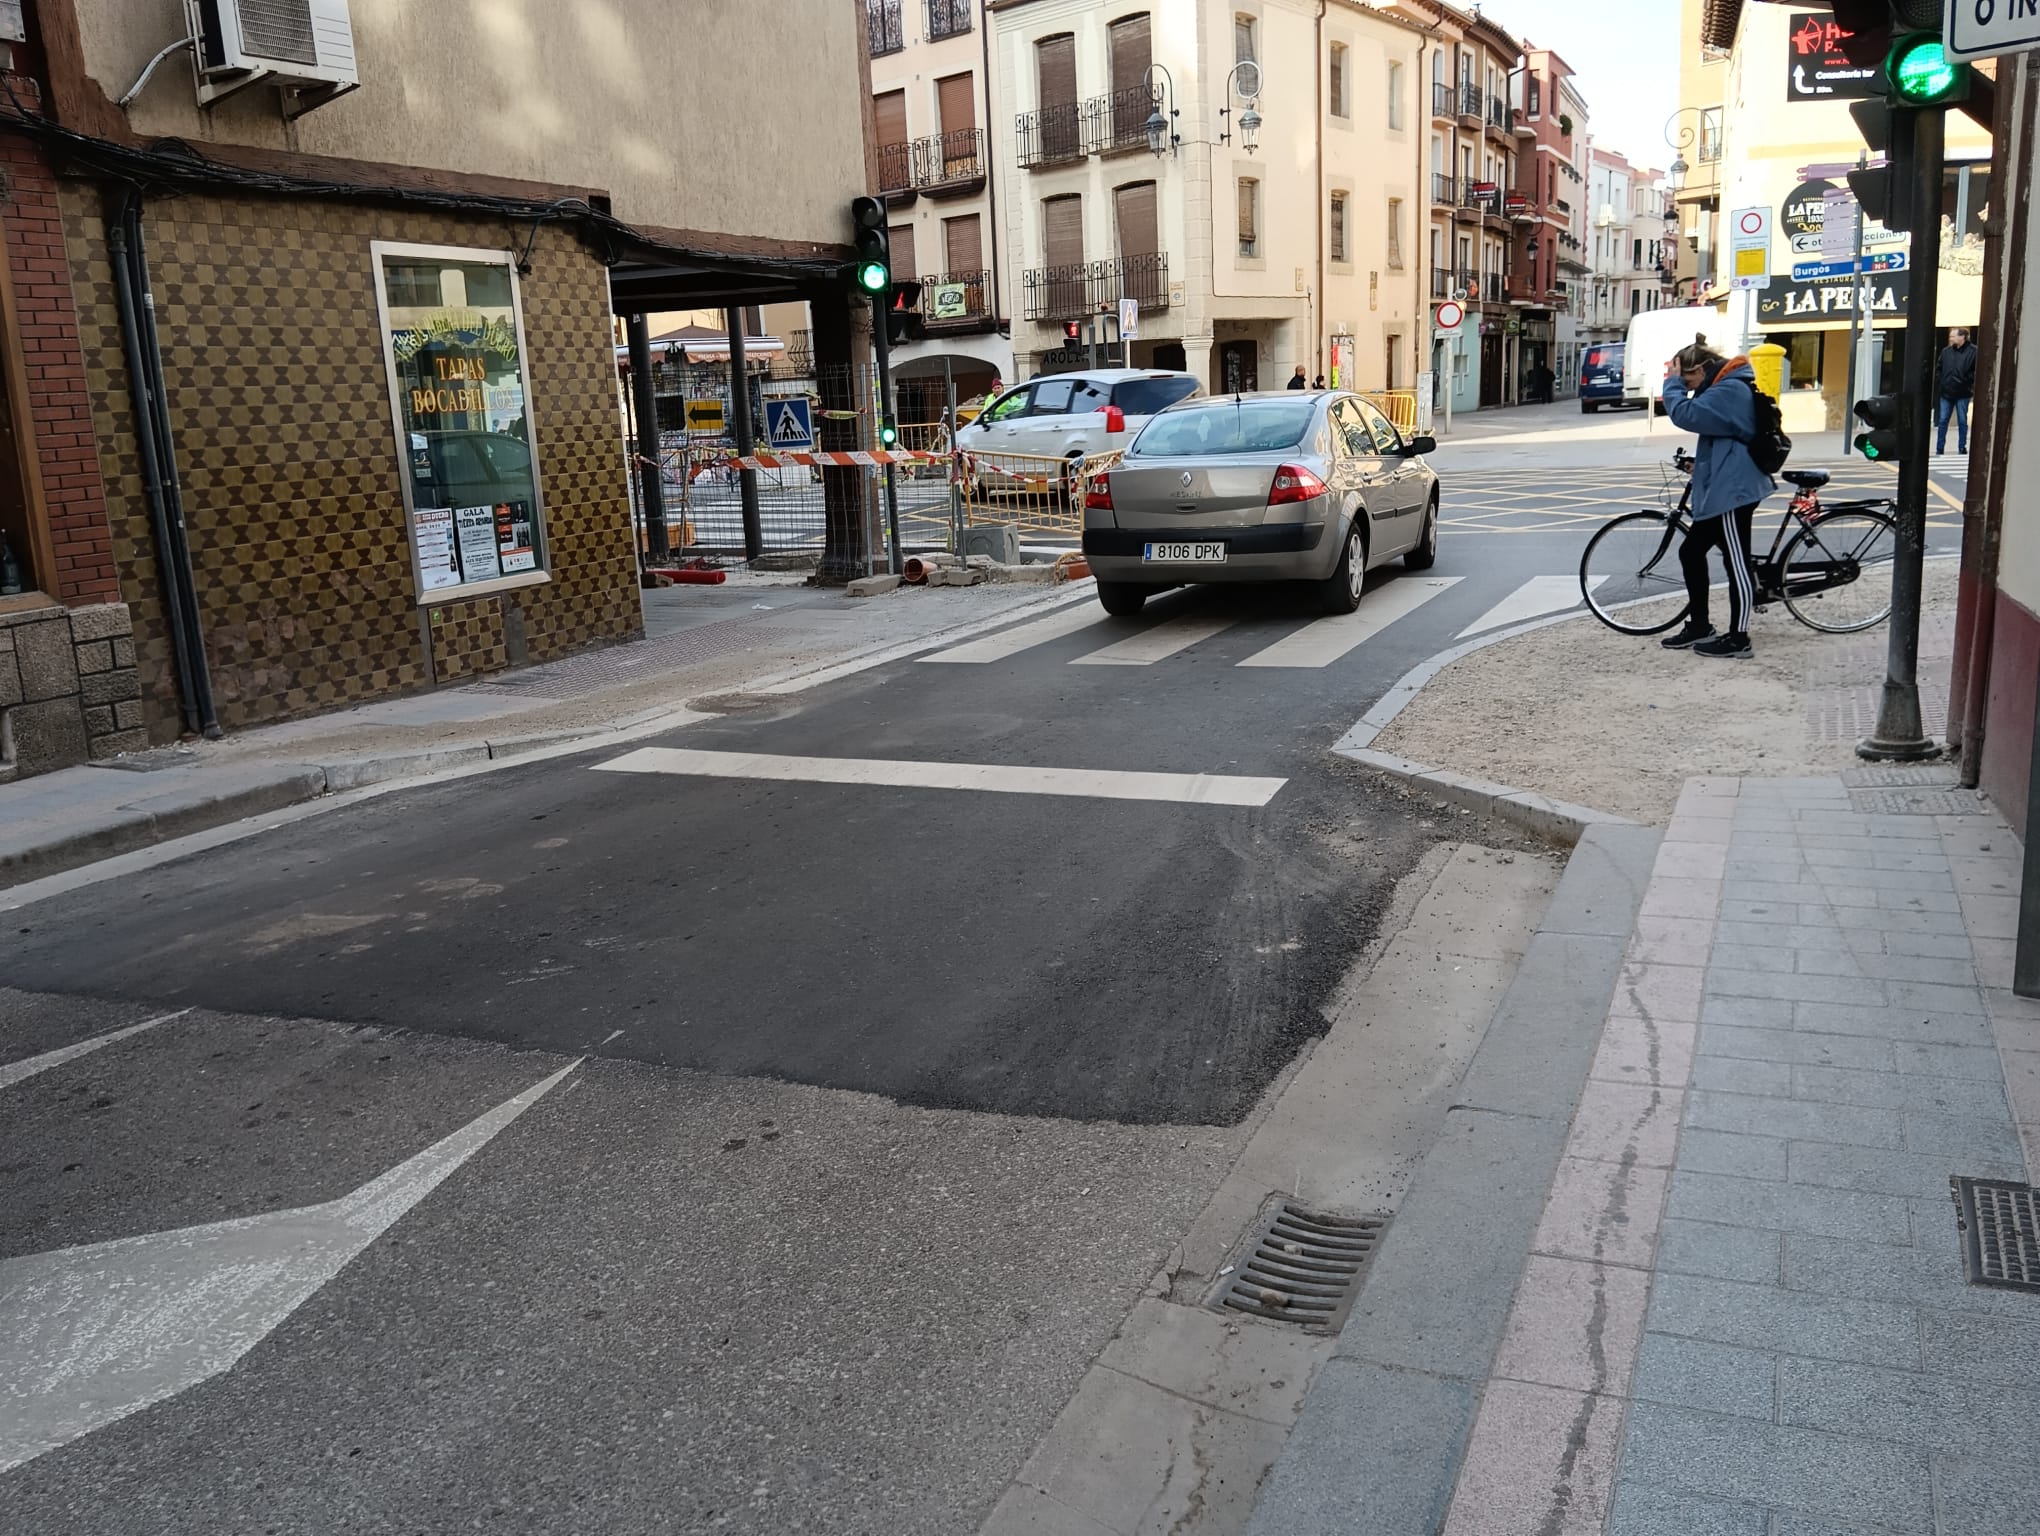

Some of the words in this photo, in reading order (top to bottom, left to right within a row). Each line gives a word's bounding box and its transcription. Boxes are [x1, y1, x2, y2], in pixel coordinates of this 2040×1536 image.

[1794, 265, 1830, 277] Burgos
[1784, 288, 1818, 315] LA
[435, 357, 486, 381] TAPAS
[412, 386, 514, 414] BOCADILLOS
[463, 507, 485, 517] GALA
[1158, 545, 1190, 559] 8106
[1195, 545, 1220, 559] DPK
